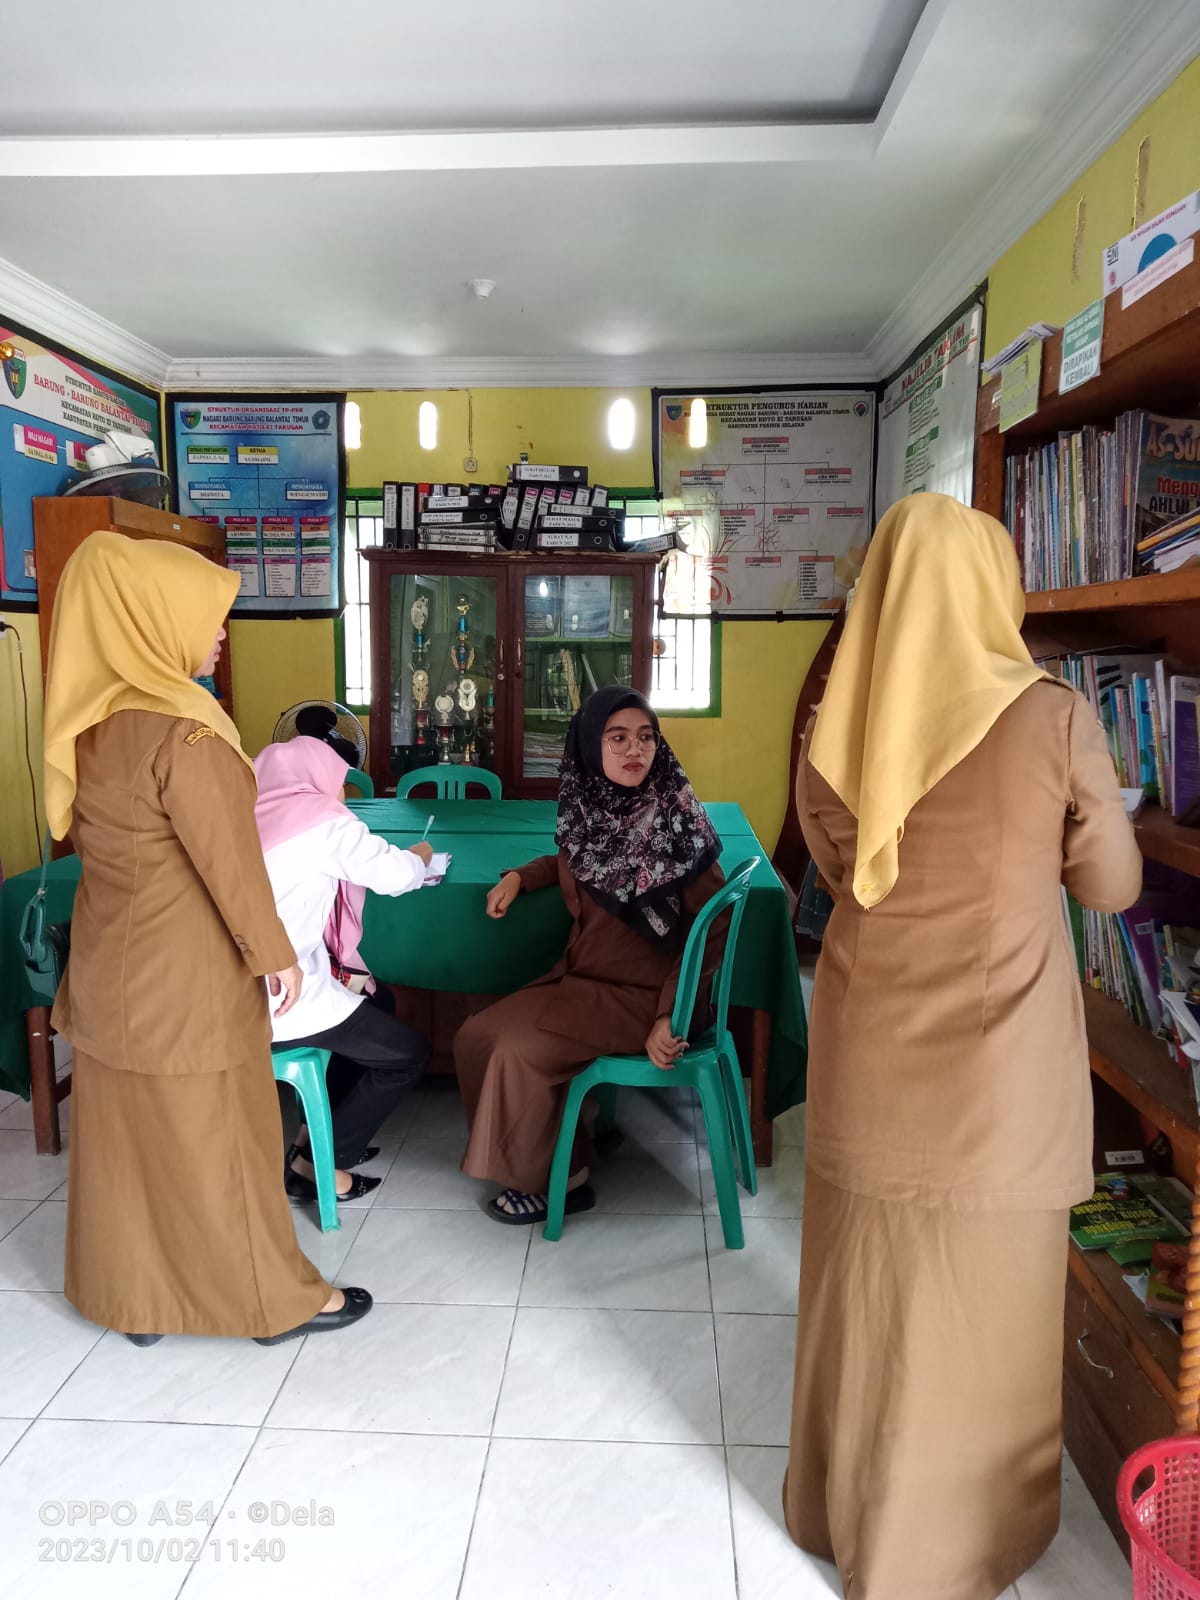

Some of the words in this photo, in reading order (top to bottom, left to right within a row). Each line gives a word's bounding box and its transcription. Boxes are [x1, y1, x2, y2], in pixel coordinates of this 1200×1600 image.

[1107, 245, 1119, 263] SNI
[1063, 345, 1097, 374] DIRAPIKAN
[1065, 362, 1093, 386] KEMBALI
[34, 374, 66, 397] BARUNG
[71, 390, 100, 410] BARUNG
[100, 402, 131, 424] BALANTAI
[706, 403, 749, 411] STRUKTUR
[751, 402, 796, 410] PENGURUS
[797, 401, 829, 410] HARIAN
[61, 400, 91, 418] KECAMATAN
[62, 412, 92, 429] KABUPATEN
[203, 415, 221, 423] NAGARI
